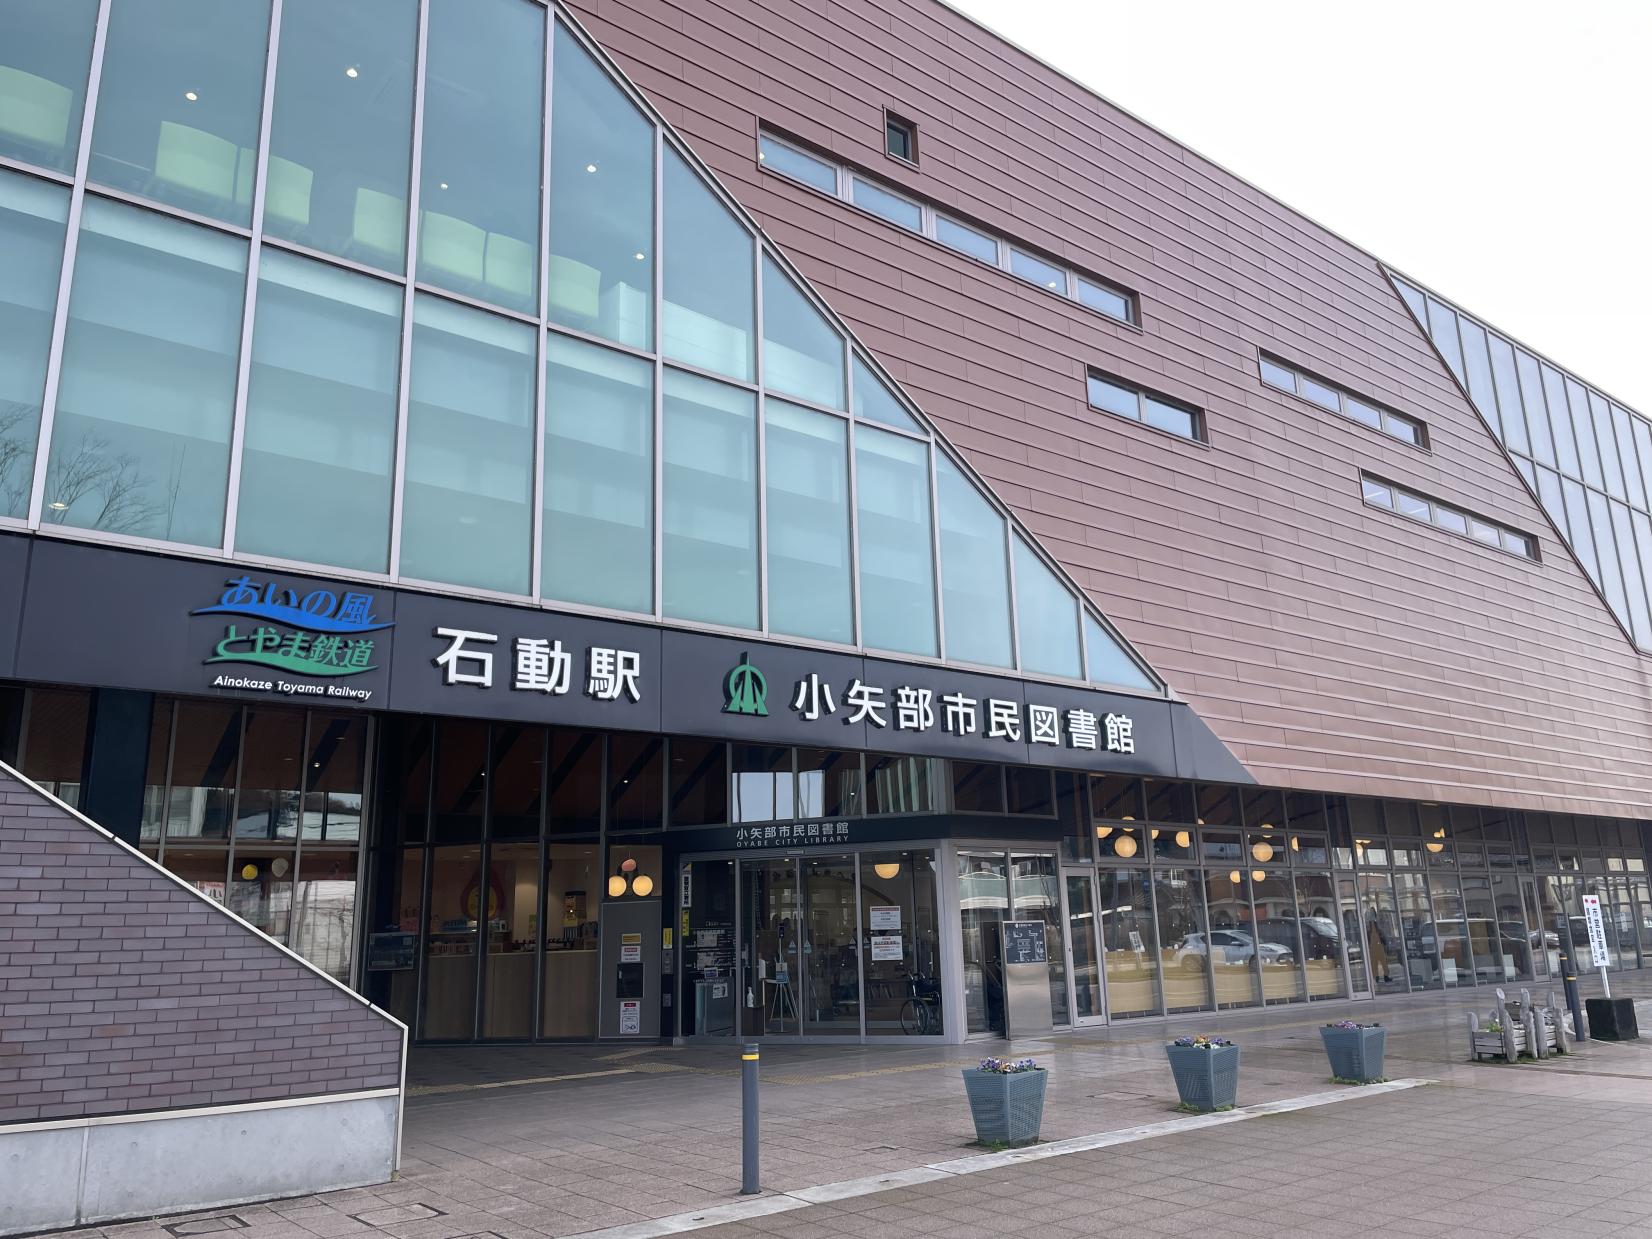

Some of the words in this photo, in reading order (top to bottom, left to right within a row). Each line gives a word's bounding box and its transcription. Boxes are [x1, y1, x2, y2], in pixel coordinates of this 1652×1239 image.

[221, 576, 377, 624] あいの風
[217, 626, 375, 667] とやま鉄道
[436, 627, 641, 702] 石動駅
[214, 675, 272, 690] Ainokaze
[277, 681, 324, 696] Toyama
[327, 685, 372, 700] Railway
[795, 673, 1136, 754] 小矢部市民図書館
[736, 822, 849, 840] 小矢部市民図書館
[736, 839, 769, 848] OYABE
[775, 838, 798, 846] CITY
[805, 835, 849, 844] LIBRARY
